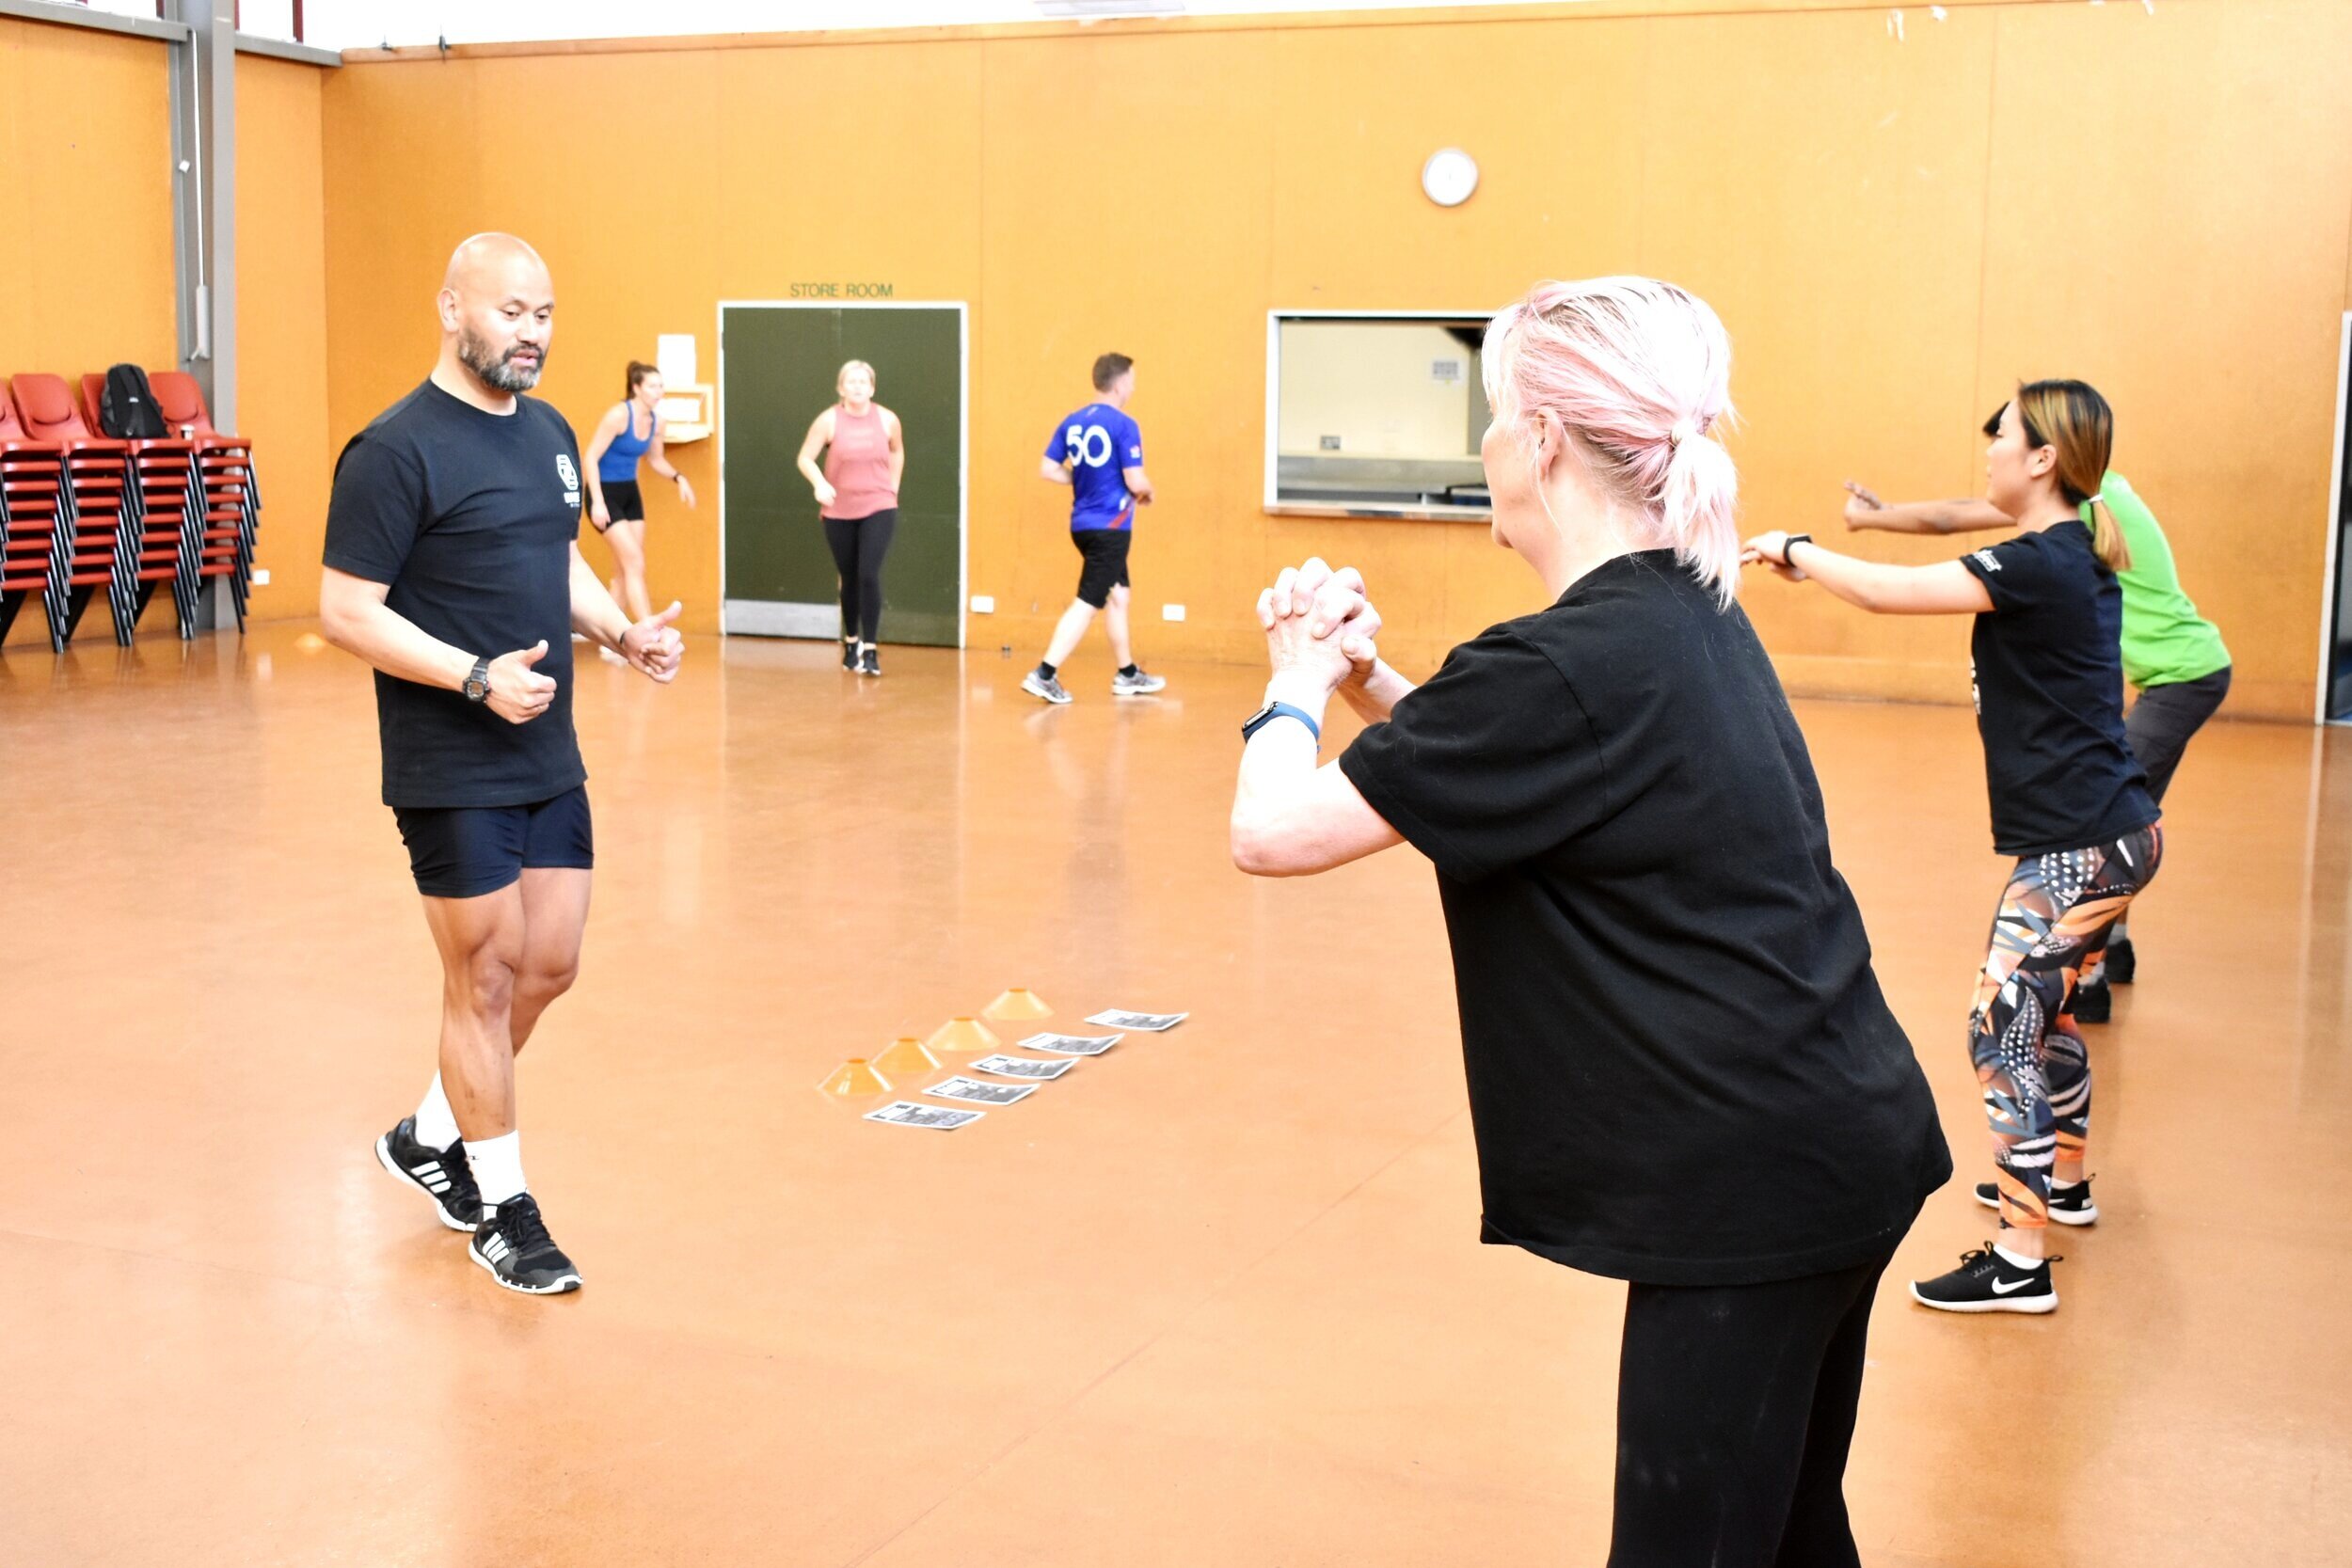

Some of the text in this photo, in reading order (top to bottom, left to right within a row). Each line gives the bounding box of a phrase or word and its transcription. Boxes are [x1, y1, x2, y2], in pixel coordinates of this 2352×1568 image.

[790, 282, 893, 297] STORE ROOM
[1066, 424, 1112, 467] 50
